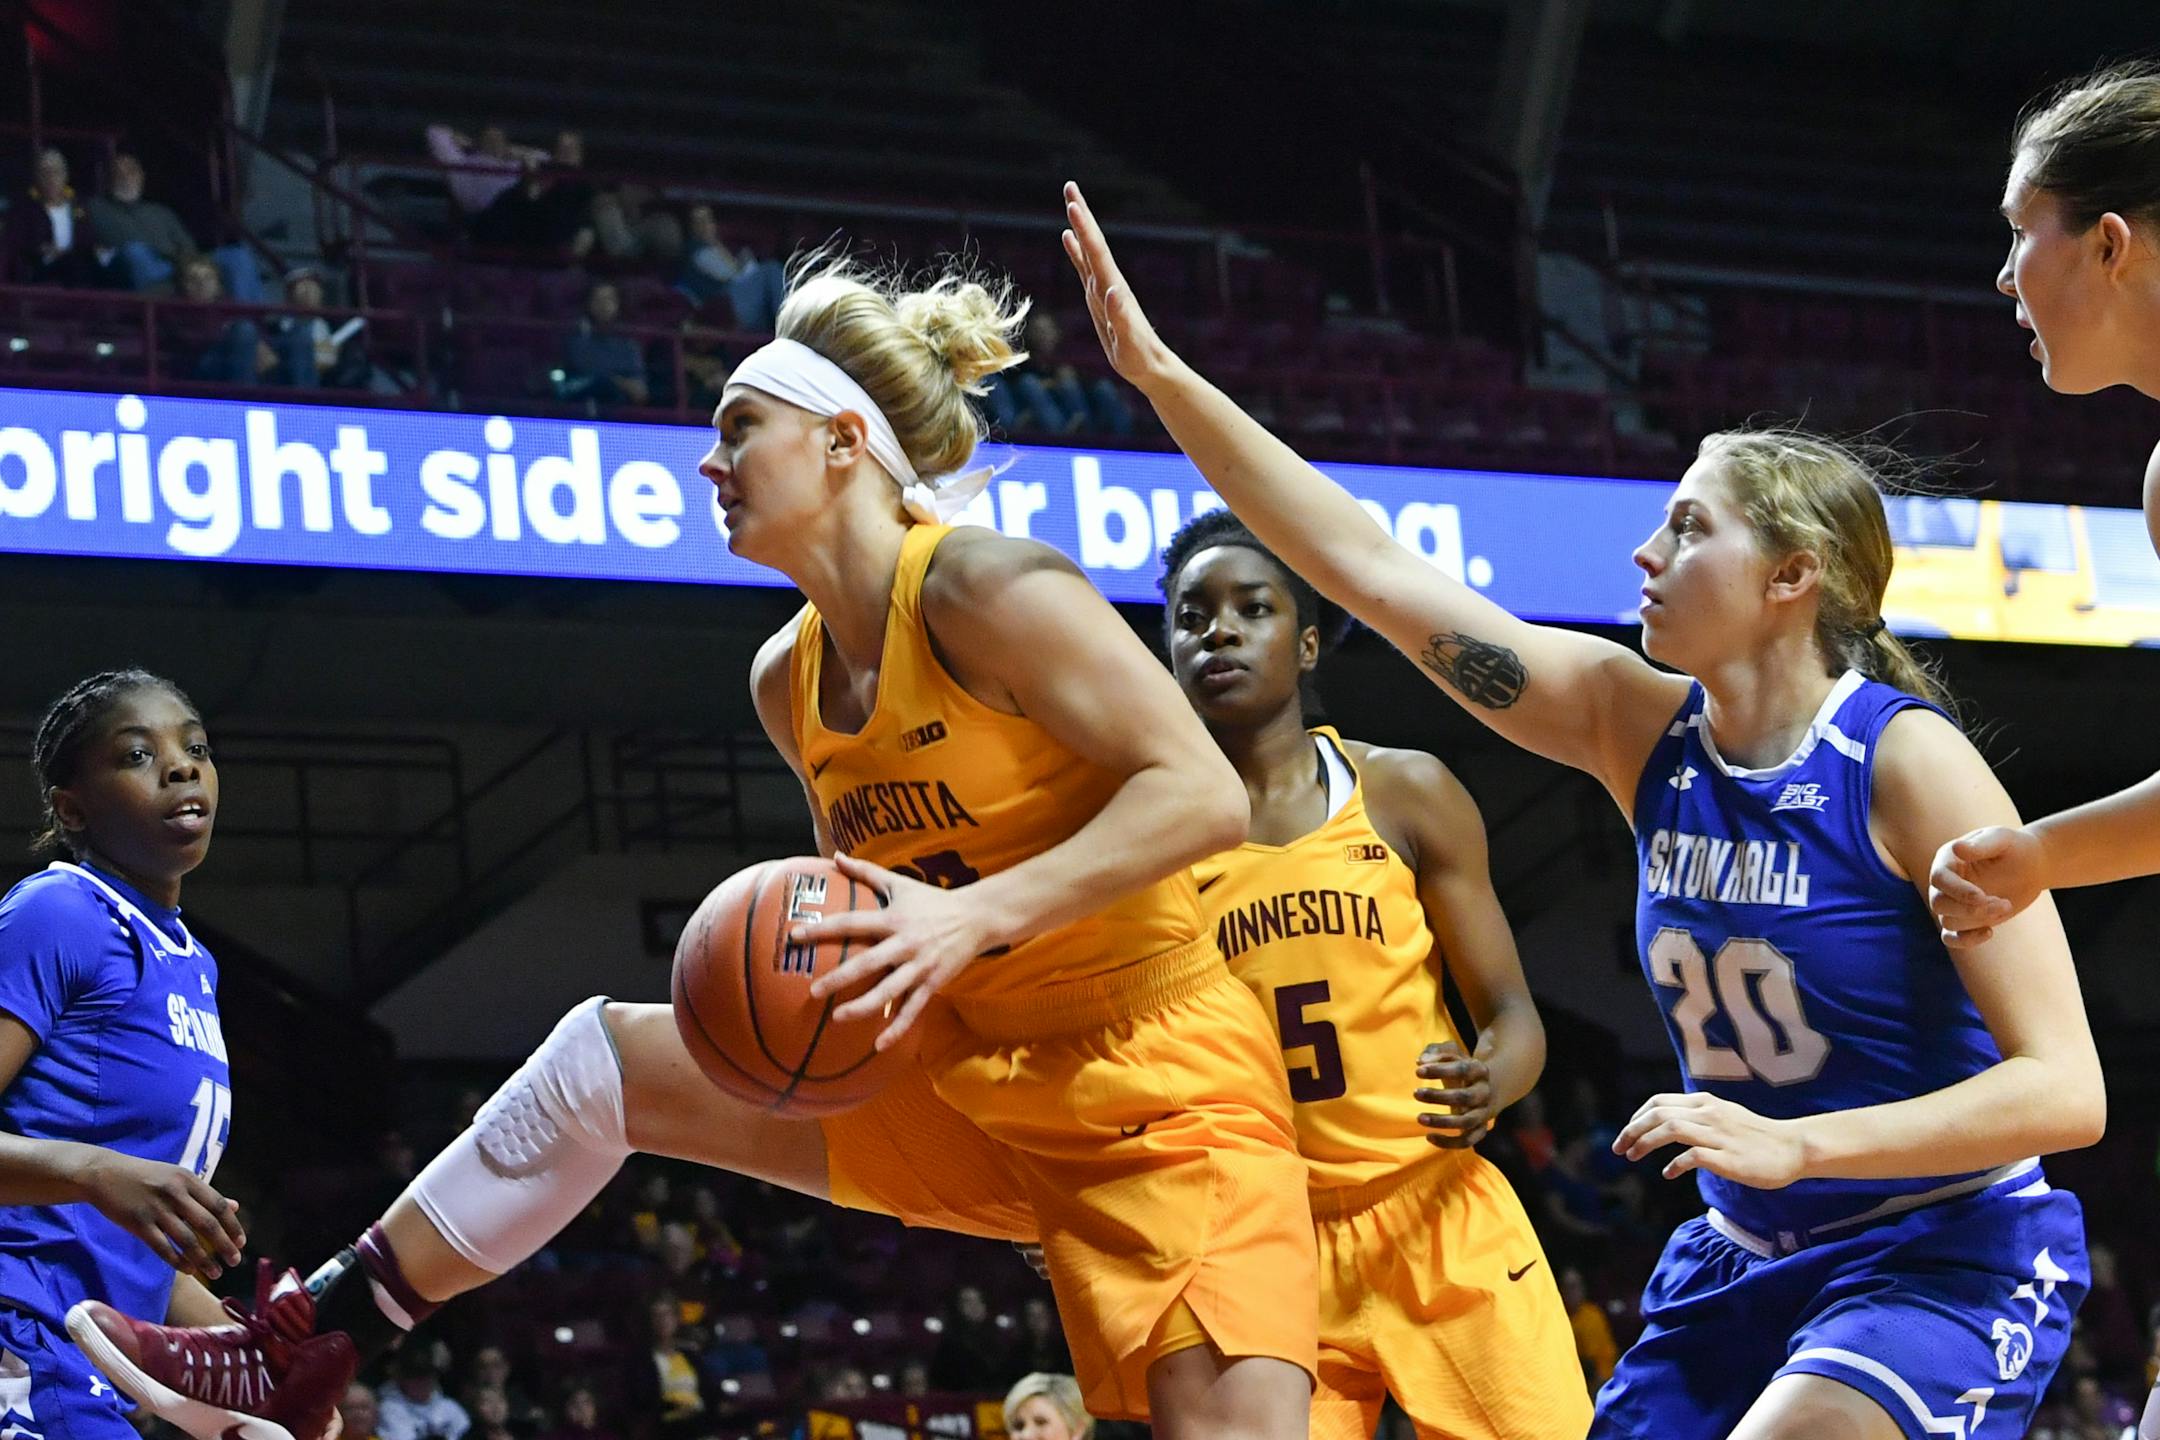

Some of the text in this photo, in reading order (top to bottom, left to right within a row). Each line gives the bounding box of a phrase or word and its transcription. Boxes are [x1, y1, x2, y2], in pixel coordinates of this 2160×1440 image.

[419, 415, 685, 549] side
[1273, 980, 1346, 1104] 5
[1648, 926, 1832, 1087] 20
